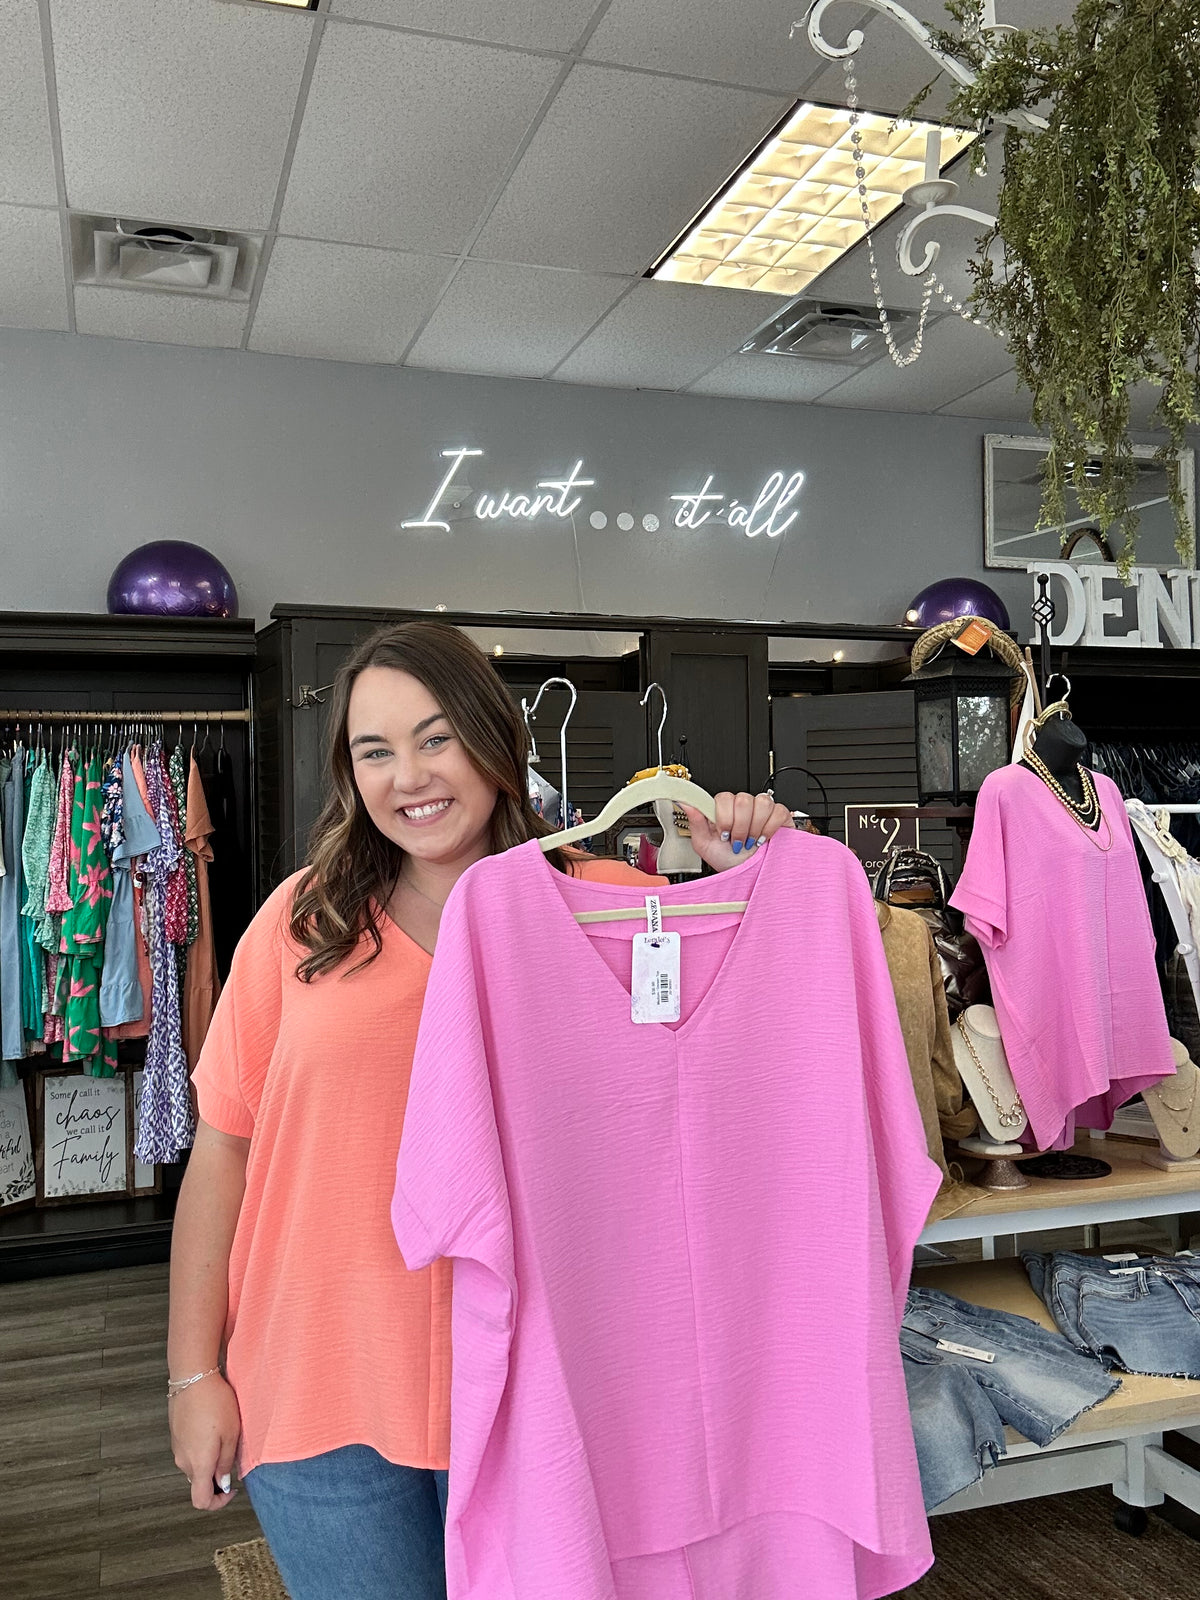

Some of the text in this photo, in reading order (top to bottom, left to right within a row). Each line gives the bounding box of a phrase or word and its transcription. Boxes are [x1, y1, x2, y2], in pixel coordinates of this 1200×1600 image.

[401, 447, 483, 533] I
[475, 459, 595, 520] want
[670, 475, 724, 529] it
[728, 472, 804, 537] all
[650, 899, 659, 933] ZENANA
[50, 1088, 101, 1100] Some call it
[56, 1089, 121, 1131] chaos
[66, 1125, 105, 1136] we call it
[51, 1135, 119, 1184] Family
